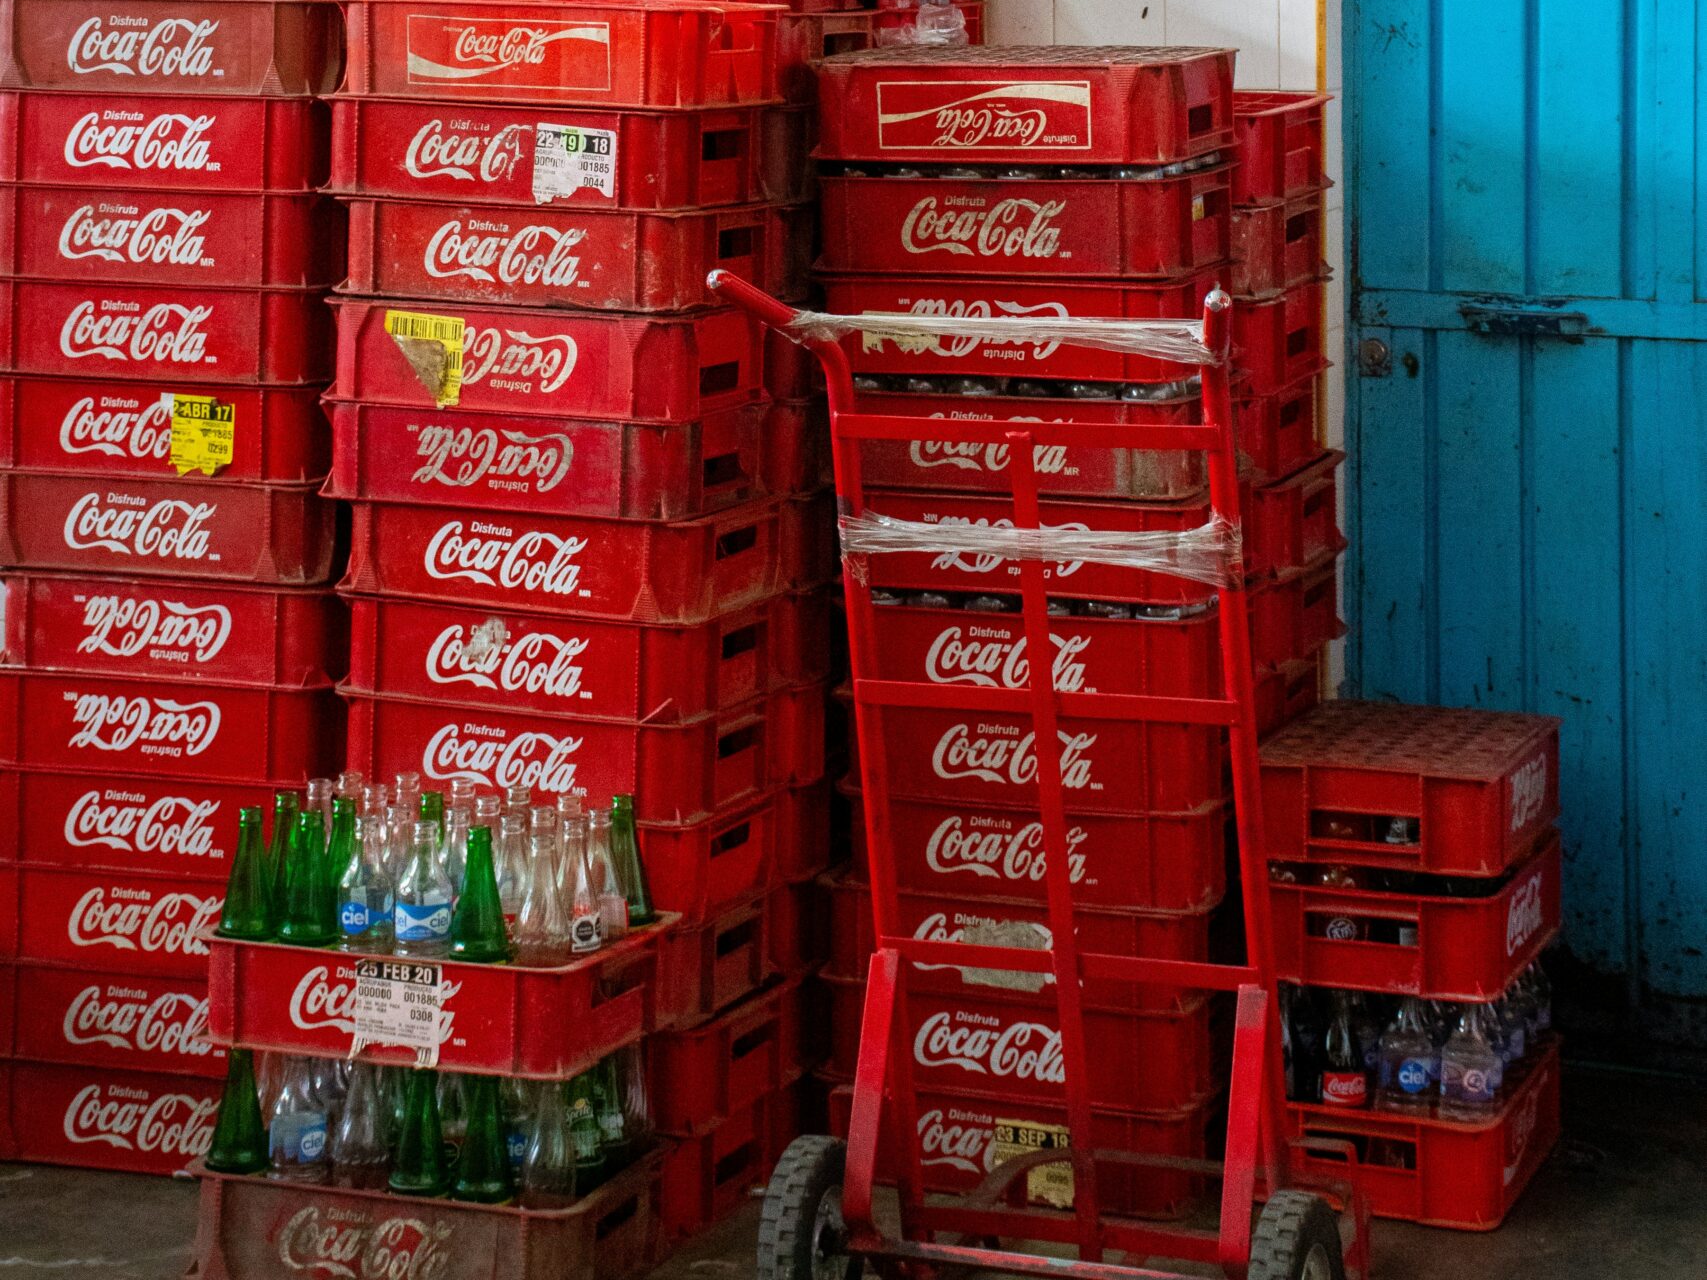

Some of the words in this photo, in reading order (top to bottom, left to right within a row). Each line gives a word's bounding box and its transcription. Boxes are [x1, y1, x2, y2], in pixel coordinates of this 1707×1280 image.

[109, 15, 148, 26] Disfruta
[68, 17, 219, 76] Coca-Cola
[455, 26, 549, 64] Coca-Cola
[103, 110, 144, 121] Disfruta
[932, 108, 1047, 146] Coca-Cola
[64, 112, 216, 170] Coca-Cola
[593, 138, 608, 154] 18
[206, 162, 221, 171] MR
[583, 177, 604, 188] 0044
[944, 195, 986, 207] Disfruta
[99, 204, 138, 215] Disfruta
[468, 219, 509, 232] Disfruta
[901, 196, 1067, 258] Coca-Cola
[59, 205, 211, 265] Coca-Cola
[424, 220, 587, 287] Coca-Cola
[200, 258, 215, 267] MR
[101, 300, 140, 311] Disfruta
[60, 301, 213, 362] Coca-Cola
[983, 348, 1025, 361] Disfruta
[490, 379, 531, 393] Disfruta
[101, 397, 139, 408] Disfruta
[183, 403, 211, 418] ABR
[215, 406, 231, 420] 17
[412, 424, 573, 493] Coca-Cola
[1064, 467, 1079, 475] MR
[488, 479, 529, 493] Disfruta
[107, 492, 146, 506] Disfruta
[64, 493, 217, 559] Coca-Cola
[470, 521, 512, 537] Disfruta
[424, 521, 588, 595] Coca-Cola
[77, 595, 232, 662] Coca-Cola
[969, 626, 1011, 639] Disfruta
[150, 649, 188, 662] Disfruta
[68, 694, 221, 755] Coca-Cola
[464, 723, 506, 737] Disfruta
[977, 724, 1019, 735] Disfruta
[141, 745, 181, 757] Disfruta
[423, 724, 583, 792] Coca-Cola
[105, 789, 146, 803] Disfruta
[572, 787, 587, 797] MR
[64, 790, 221, 856] Coca-Cola
[970, 816, 1012, 828] Disfruta
[210, 848, 224, 858] MR
[111, 887, 151, 899] Disfruta
[341, 904, 369, 925] ciel
[429, 911, 450, 928] ciel
[360, 963, 378, 977] 25
[383, 964, 410, 981] FEB
[415, 967, 432, 984] 20
[107, 985, 147, 999] Disfruta
[410, 1009, 433, 1022] 0308
[956, 1011, 999, 1026] Disfruta
[453, 1038, 466, 1046] MR
[108, 1085, 149, 1099] Disfruta
[64, 1084, 222, 1156] Coca-Cola
[949, 1109, 992, 1123] Disfruta
[303, 1133, 325, 1153] ciel
[1019, 1128, 1046, 1146] SEP
